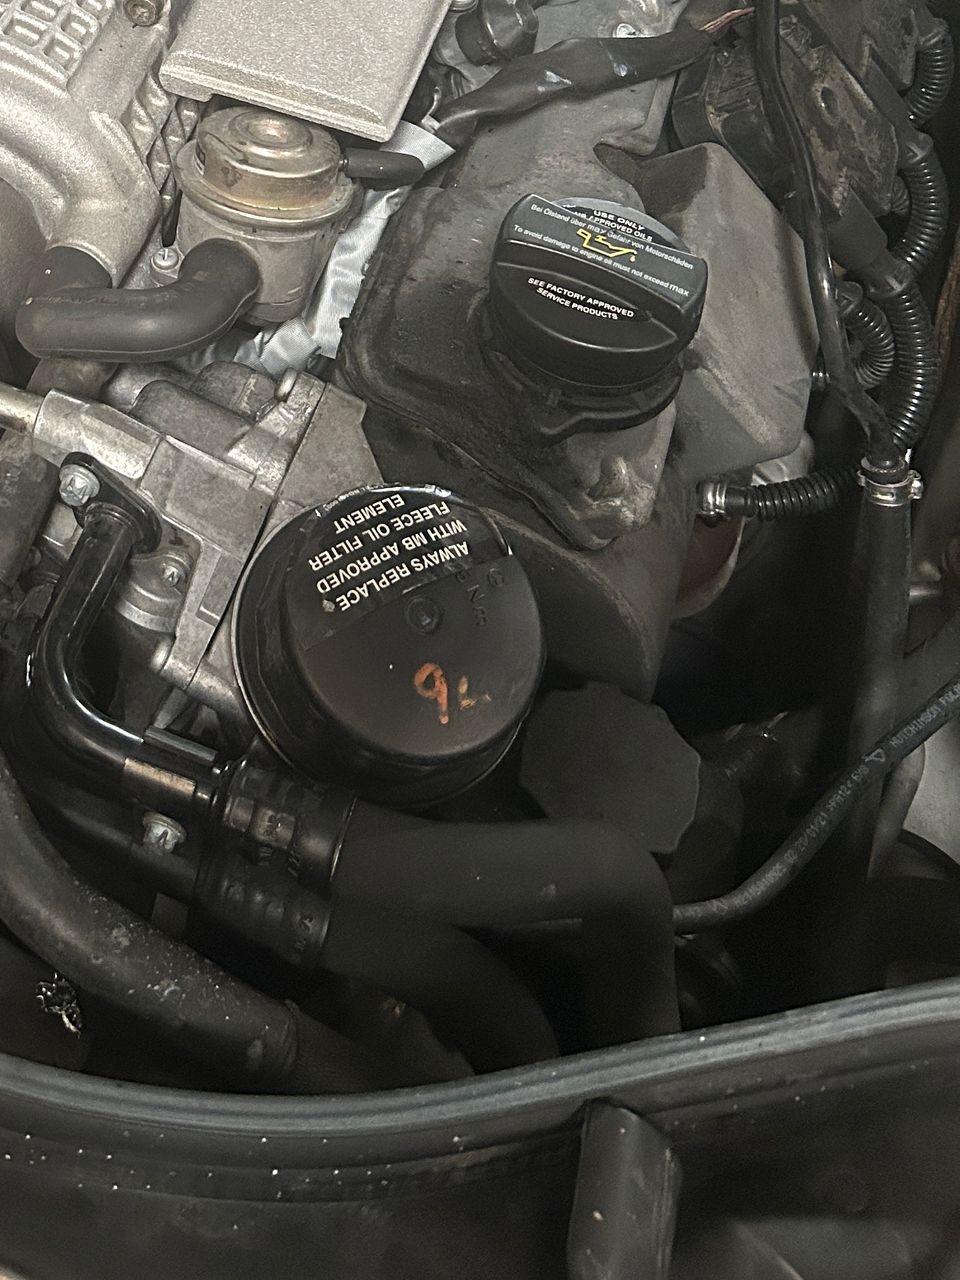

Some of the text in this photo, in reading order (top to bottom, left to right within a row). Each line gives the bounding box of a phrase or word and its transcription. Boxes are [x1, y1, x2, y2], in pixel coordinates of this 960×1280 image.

[530, 203, 694, 270] Bei Ölstand über max Gefahr von Motorschäden
[593, 209, 646, 231] USE ONLY
[633, 229, 653, 243] OILS
[513, 223, 690, 297] To avoid damage to engine oil must not exceed max
[527, 276, 634, 318] SEE FACTORY APPROVED
[536, 286, 619, 320] SERVICE PRODUCTS
[333, 493, 406, 535] ELEMENT
[308, 501, 451, 572] FLEECE OIL FILTER
[316, 519, 468, 594] WITH MB APPROVED
[410, 541, 469, 574] ALWAYS
[335, 561, 411, 612] REPLACE
